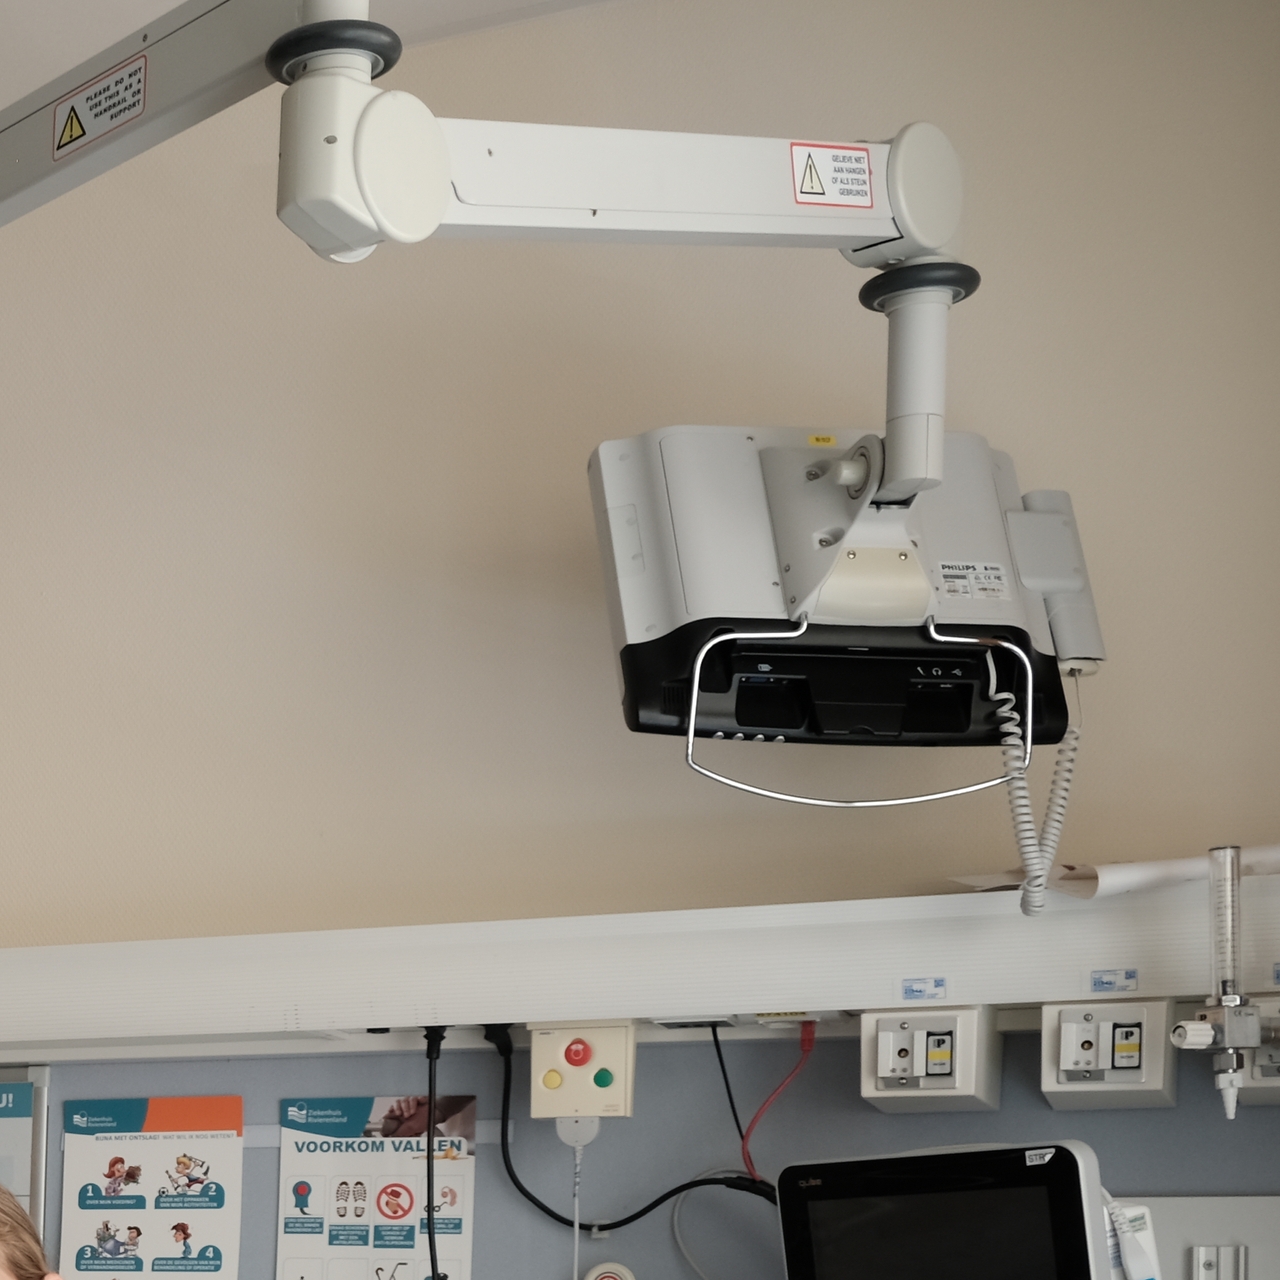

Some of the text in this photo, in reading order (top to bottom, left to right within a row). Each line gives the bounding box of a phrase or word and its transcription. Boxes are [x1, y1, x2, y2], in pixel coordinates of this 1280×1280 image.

[85, 66, 142, 104] PLEASE DO NOT
[89, 99, 102, 112] USE
[104, 90, 120, 103] THIS
[123, 82, 133, 93] AS
[93, 88, 142, 119] HANDRAIL OR
[109, 98, 142, 121] SUPPORT
[294, 1140, 385, 1154] VOORKOM
[86, 1185, 94, 1196] 1
[208, 1184, 217, 1195] 2
[83, 1246, 91, 1258] 3
[205, 1247, 214, 1258] 4
